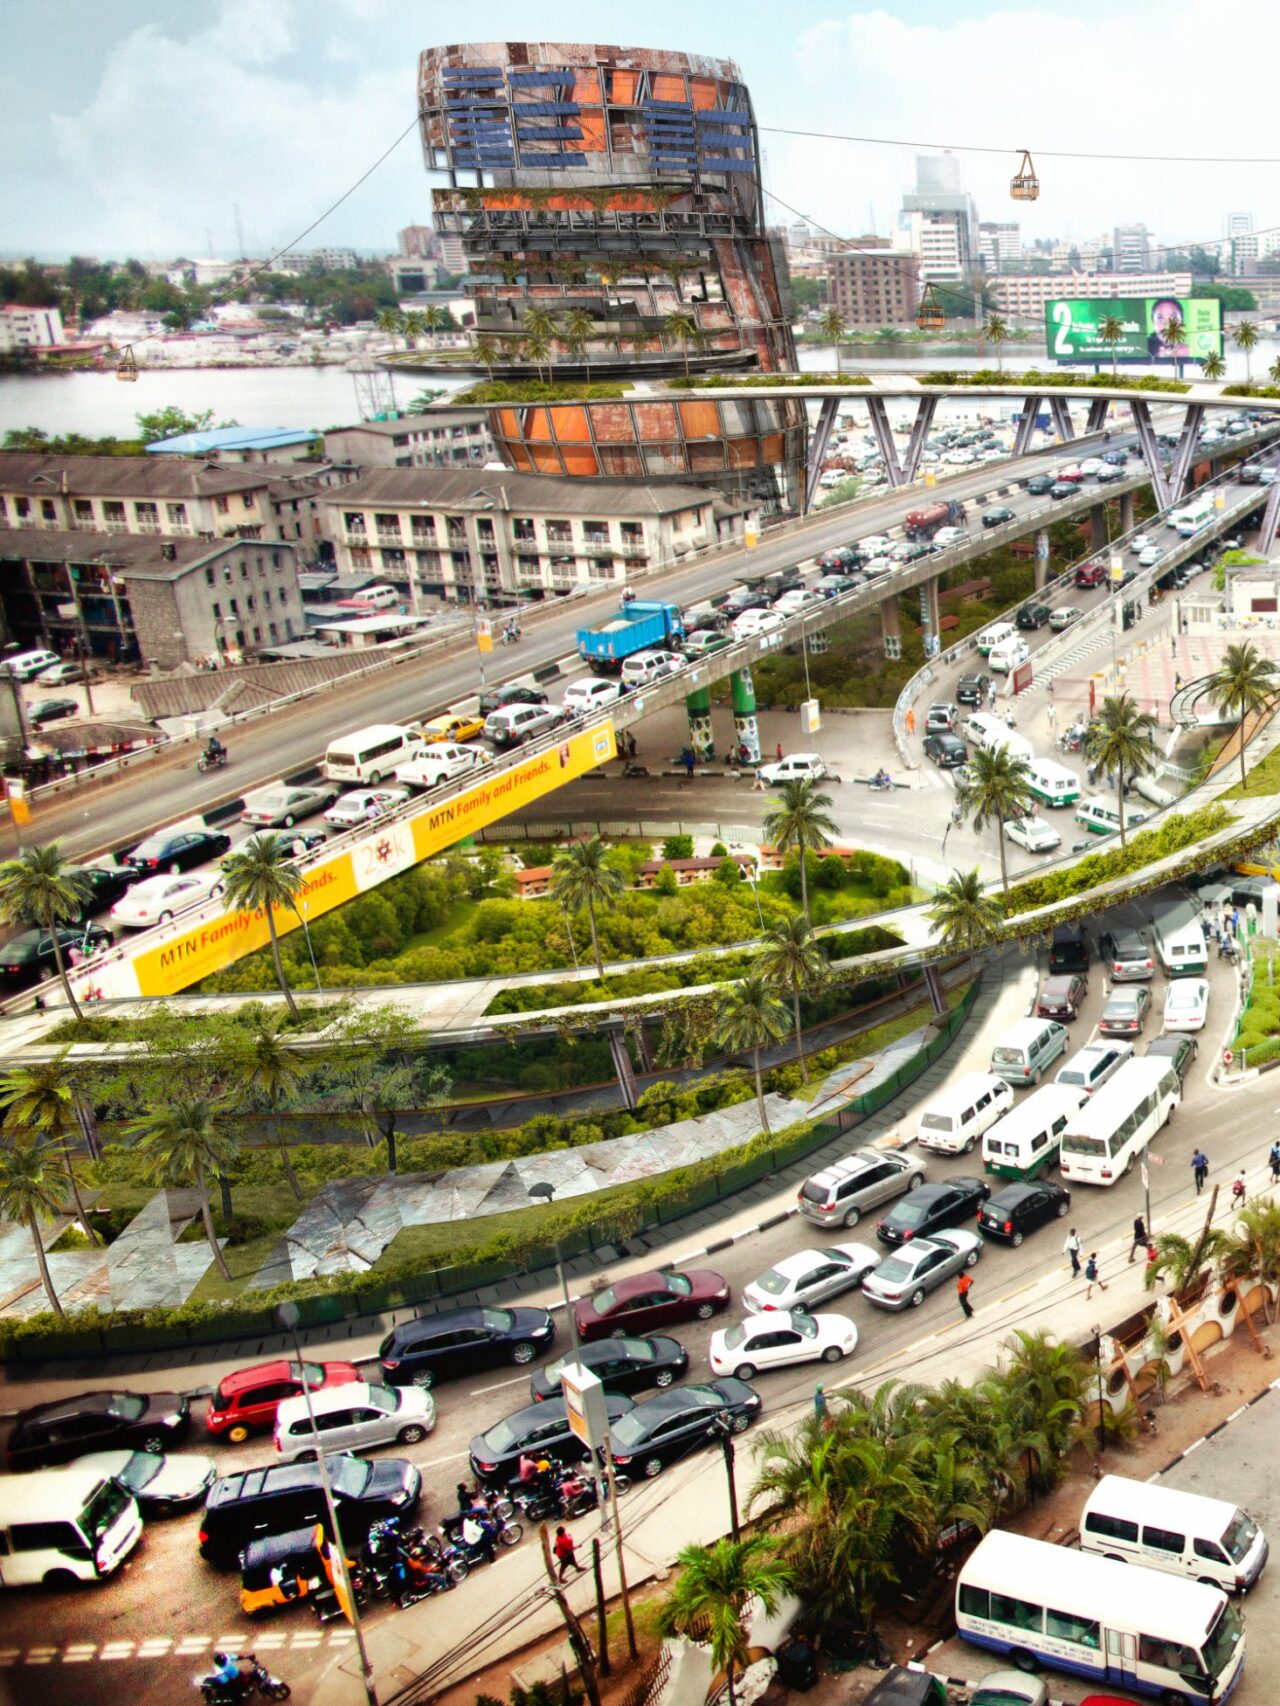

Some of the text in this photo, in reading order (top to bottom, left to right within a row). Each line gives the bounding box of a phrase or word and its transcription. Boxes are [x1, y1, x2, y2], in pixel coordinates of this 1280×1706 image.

[1053, 302, 1074, 354] 2
[429, 807, 454, 831] MTN
[456, 789, 491, 817] Family
[493, 776, 512, 798] and
[514, 761, 552, 787] Friends.
[160, 938, 196, 968] MTN
[200, 909, 251, 948] Family
